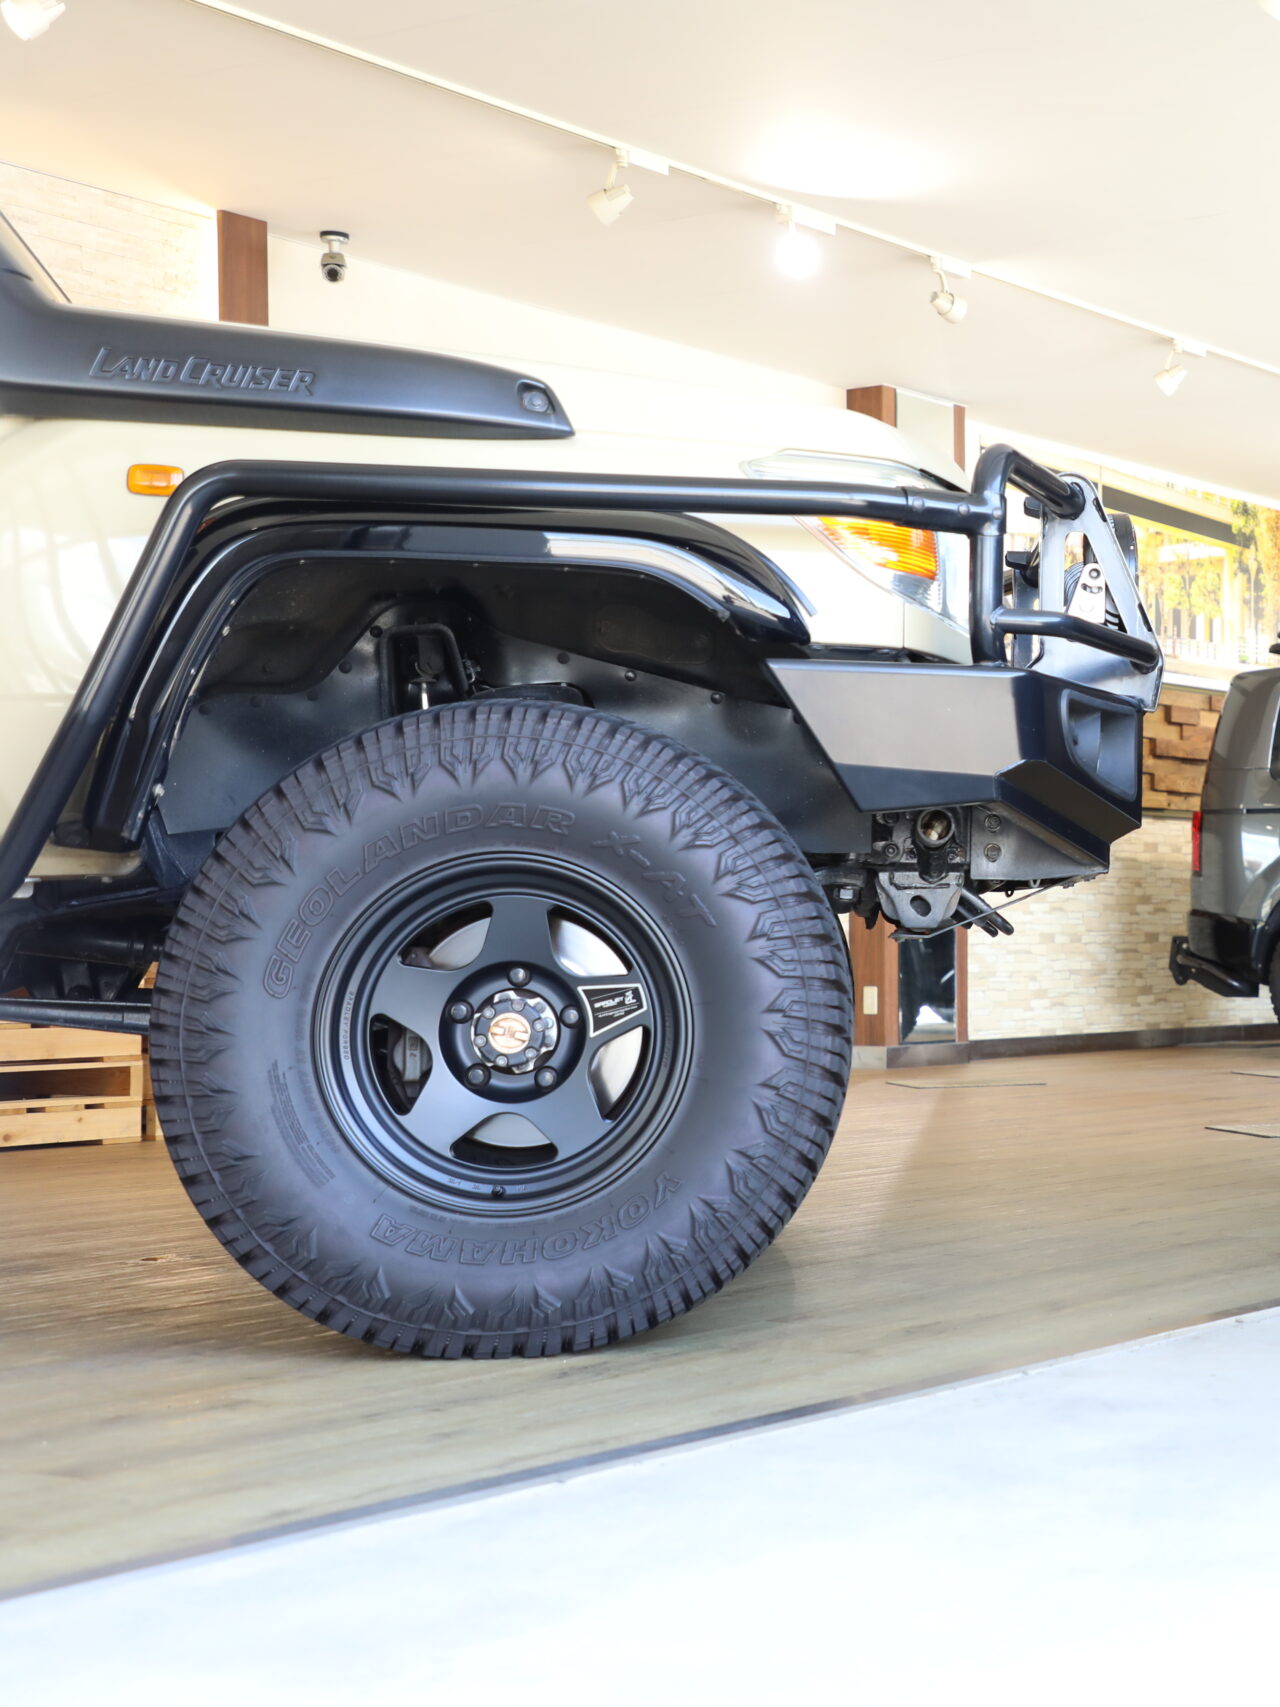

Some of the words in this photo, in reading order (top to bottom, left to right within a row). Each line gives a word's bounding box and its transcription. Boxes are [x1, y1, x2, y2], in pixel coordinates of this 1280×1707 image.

[88, 346, 180, 383] LAND
[179, 355, 317, 396] CRUISER
[262, 802, 576, 999] GEOLANDAR
[590, 830, 718, 927] X-AT
[370, 1171, 684, 1265] YOKOHAMA
